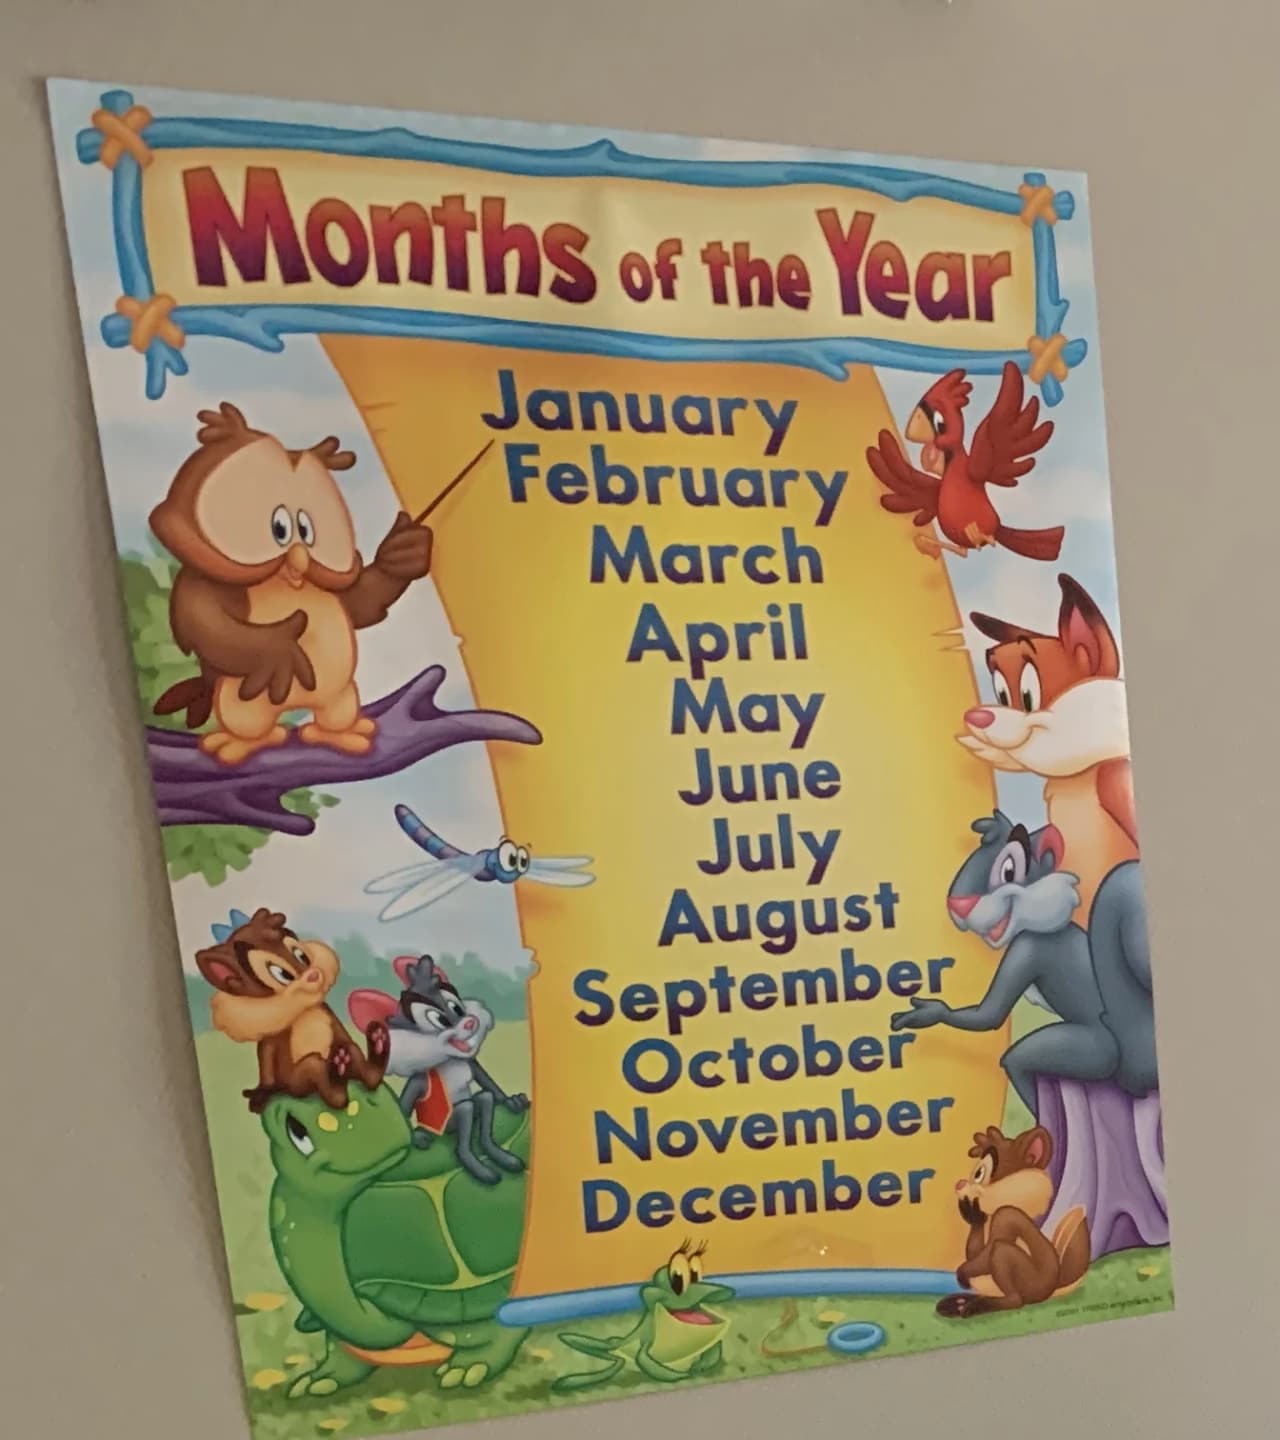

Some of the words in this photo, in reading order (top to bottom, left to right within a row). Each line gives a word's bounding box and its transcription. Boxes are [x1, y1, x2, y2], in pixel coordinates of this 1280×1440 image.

[182, 166, 598, 305] Months
[618, 240, 684, 303] of
[700, 241, 813, 313] the
[815, 207, 1013, 327] Year
[481, 368, 799, 457] January
[504, 441, 850, 525] February
[589, 524, 825, 586] March
[626, 603, 809, 681] April
[670, 676, 826, 751] May
[678, 746, 844, 810] June
[697, 815, 843, 888] July
[658, 881, 900, 954] August
[573, 947, 956, 1036] September
[620, 1022, 918, 1097] October
[593, 1087, 956, 1168] November
[582, 1156, 938, 1238] December
